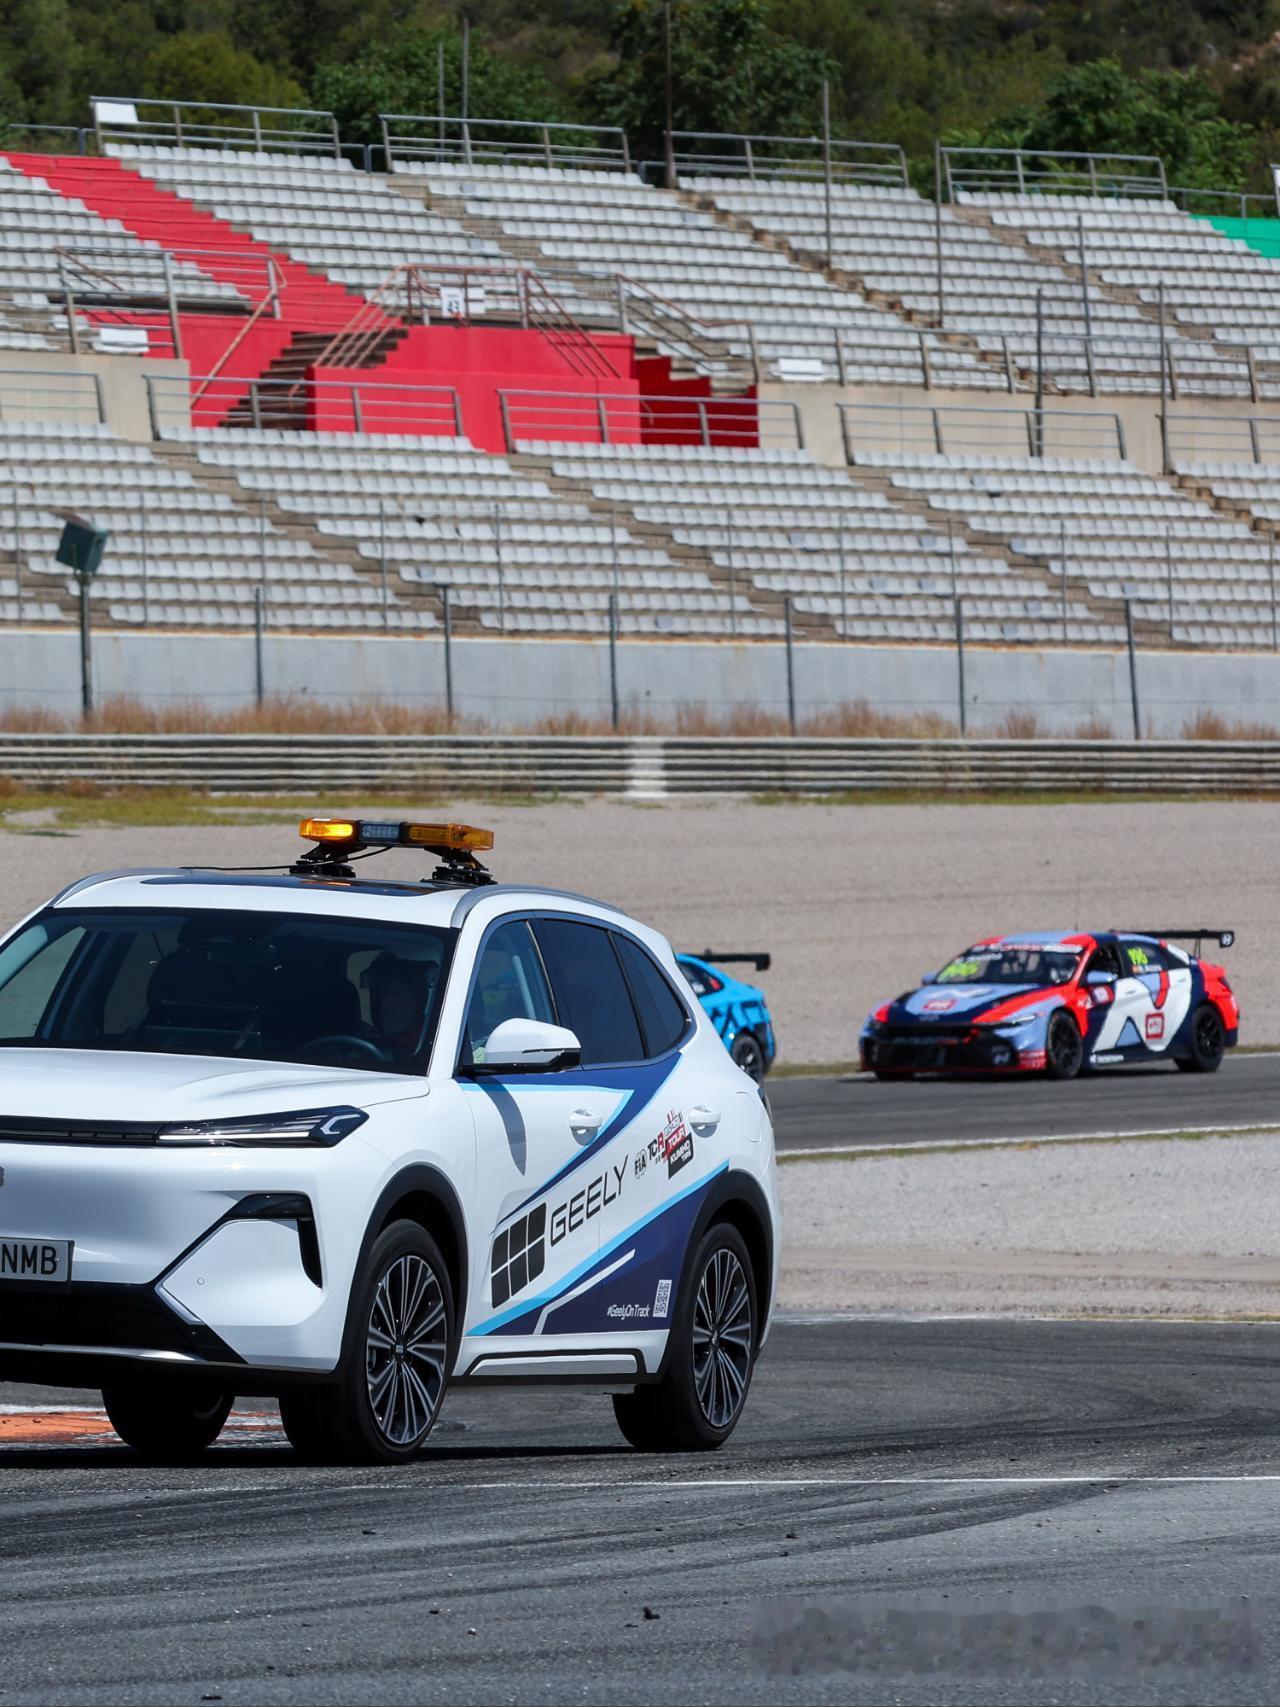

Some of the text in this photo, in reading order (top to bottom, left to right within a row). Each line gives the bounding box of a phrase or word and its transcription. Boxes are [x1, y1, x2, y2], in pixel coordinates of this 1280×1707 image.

[550, 1153, 647, 1248] GEELY FIA
[1, 1243, 58, 1275] NMB
[606, 1303, 651, 1321] #GeelyOnTrack
